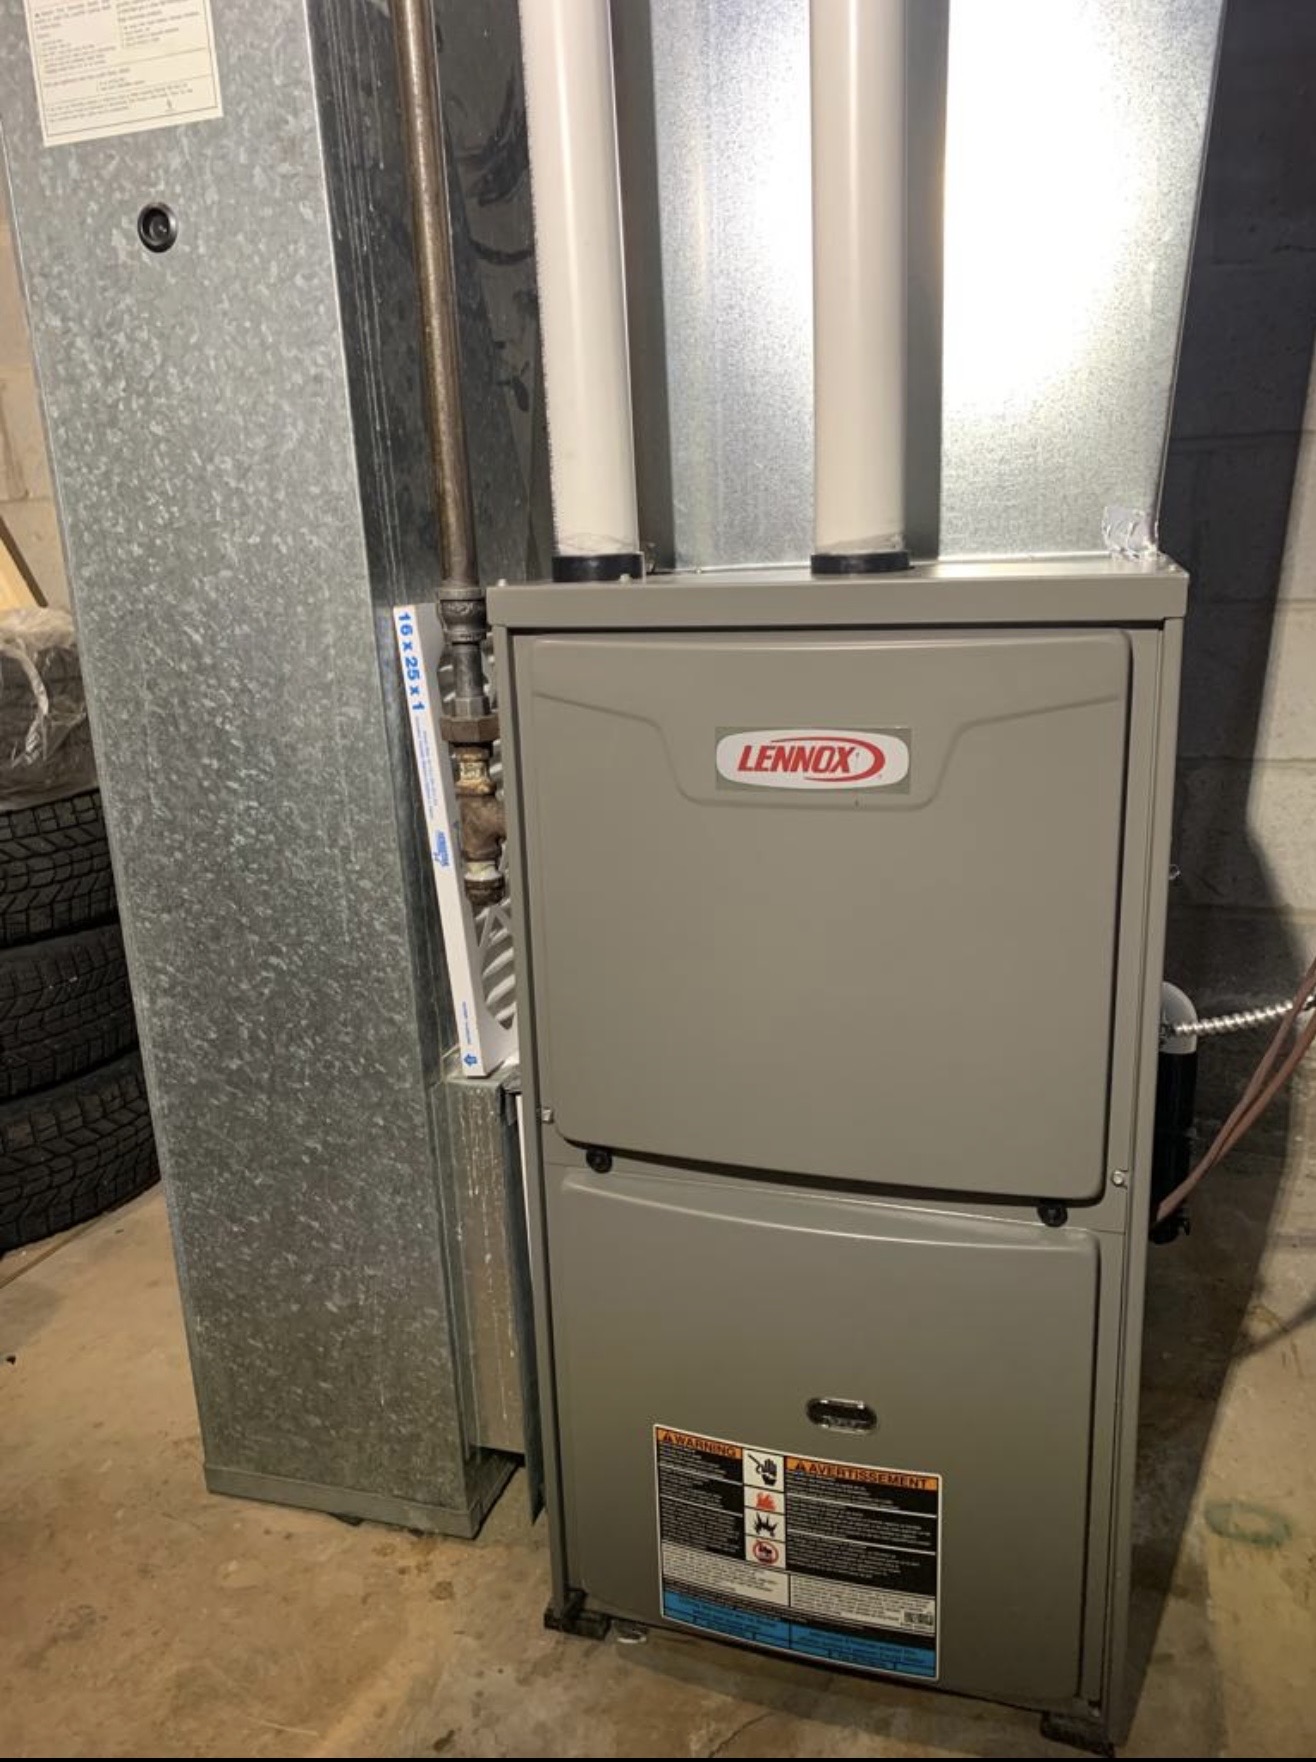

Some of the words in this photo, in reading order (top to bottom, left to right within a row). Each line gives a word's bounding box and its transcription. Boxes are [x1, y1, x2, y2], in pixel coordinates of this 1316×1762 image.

[398, 611, 414, 636] 16
[402, 641, 413, 652] x
[405, 656, 420, 680] 25
[410, 686, 420, 696] x
[412, 701, 425, 710] 1
[737, 745, 855, 773] LENNOX
[675, 1434, 736, 1457] WARNING
[809, 1464, 928, 1489] AVERTISSEMENT
